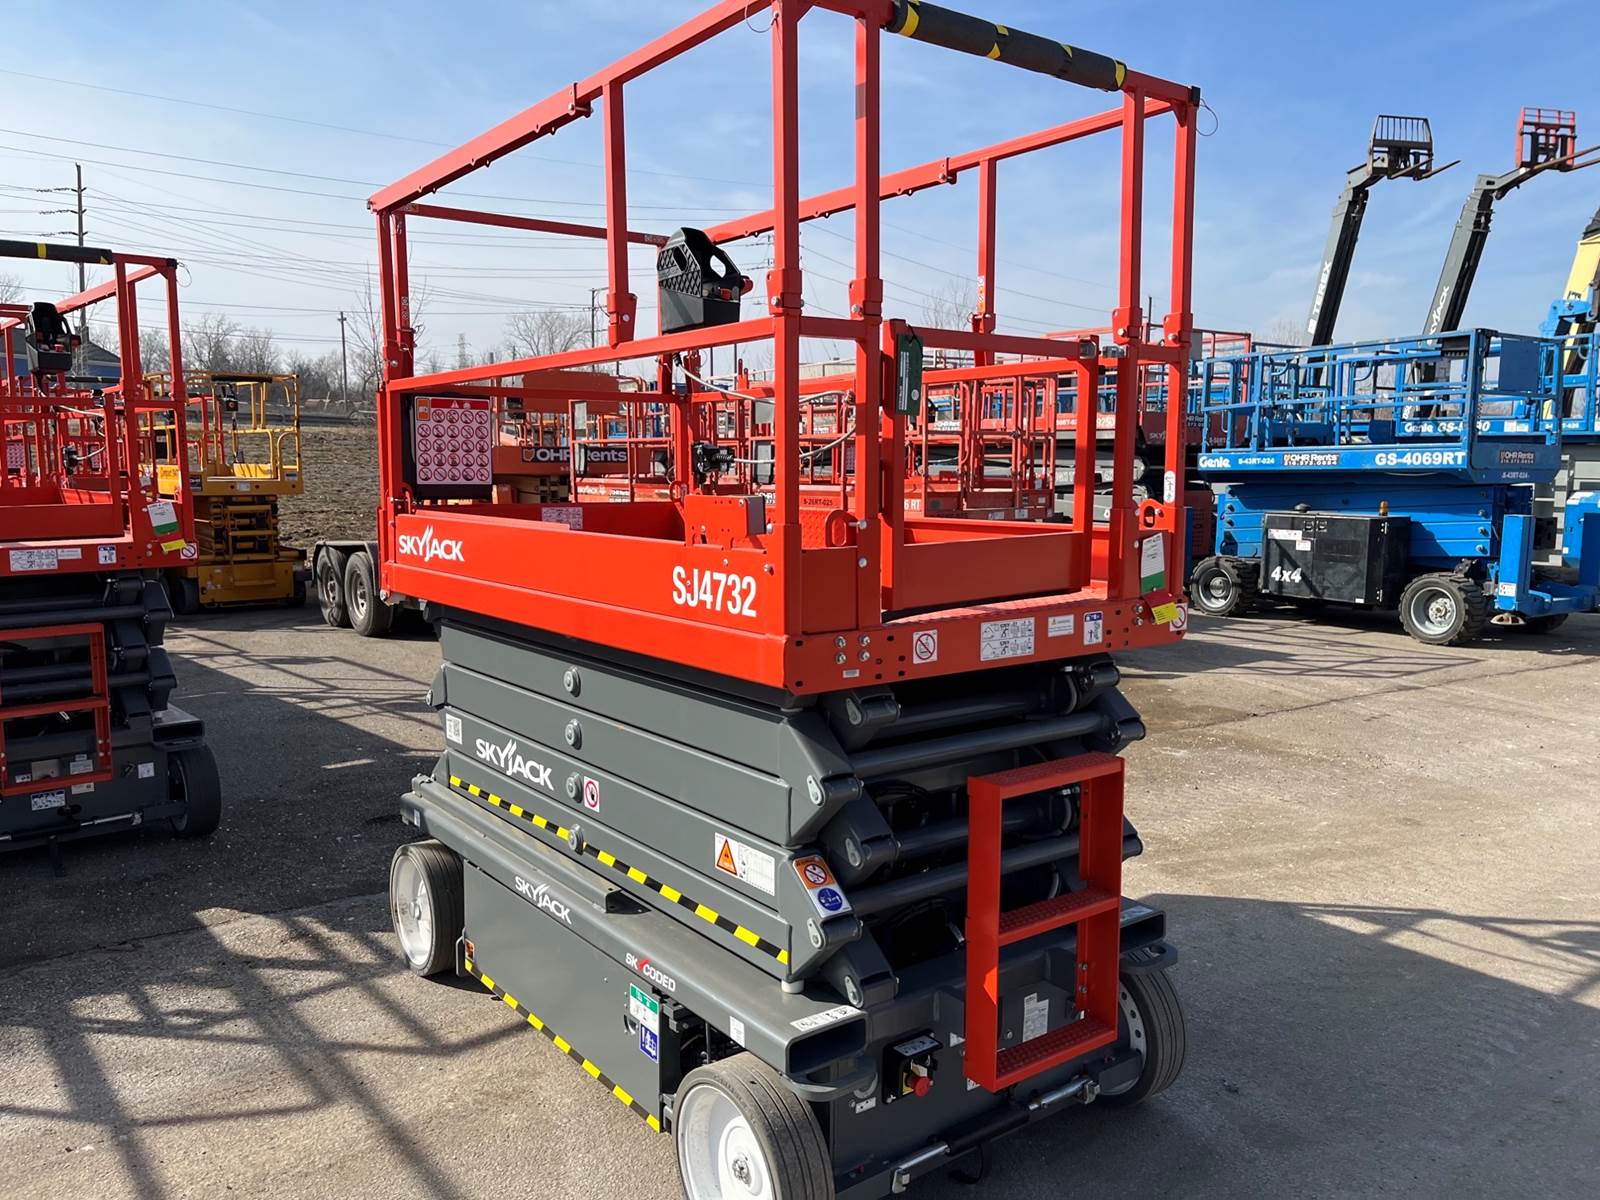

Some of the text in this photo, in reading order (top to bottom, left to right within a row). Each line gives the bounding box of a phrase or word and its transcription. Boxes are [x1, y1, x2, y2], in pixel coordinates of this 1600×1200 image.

[1405, 422, 1434, 433] Genie
[1199, 456, 1231, 468] Genie
[1375, 452, 1467, 465] GS-4069RT
[399, 525, 465, 562] SKYJACK
[1271, 566, 1302, 583] 4x4
[672, 565, 757, 617] SJ4732
[475, 739, 555, 791] SKYJACK
[515, 876, 572, 925] SKYJACK
